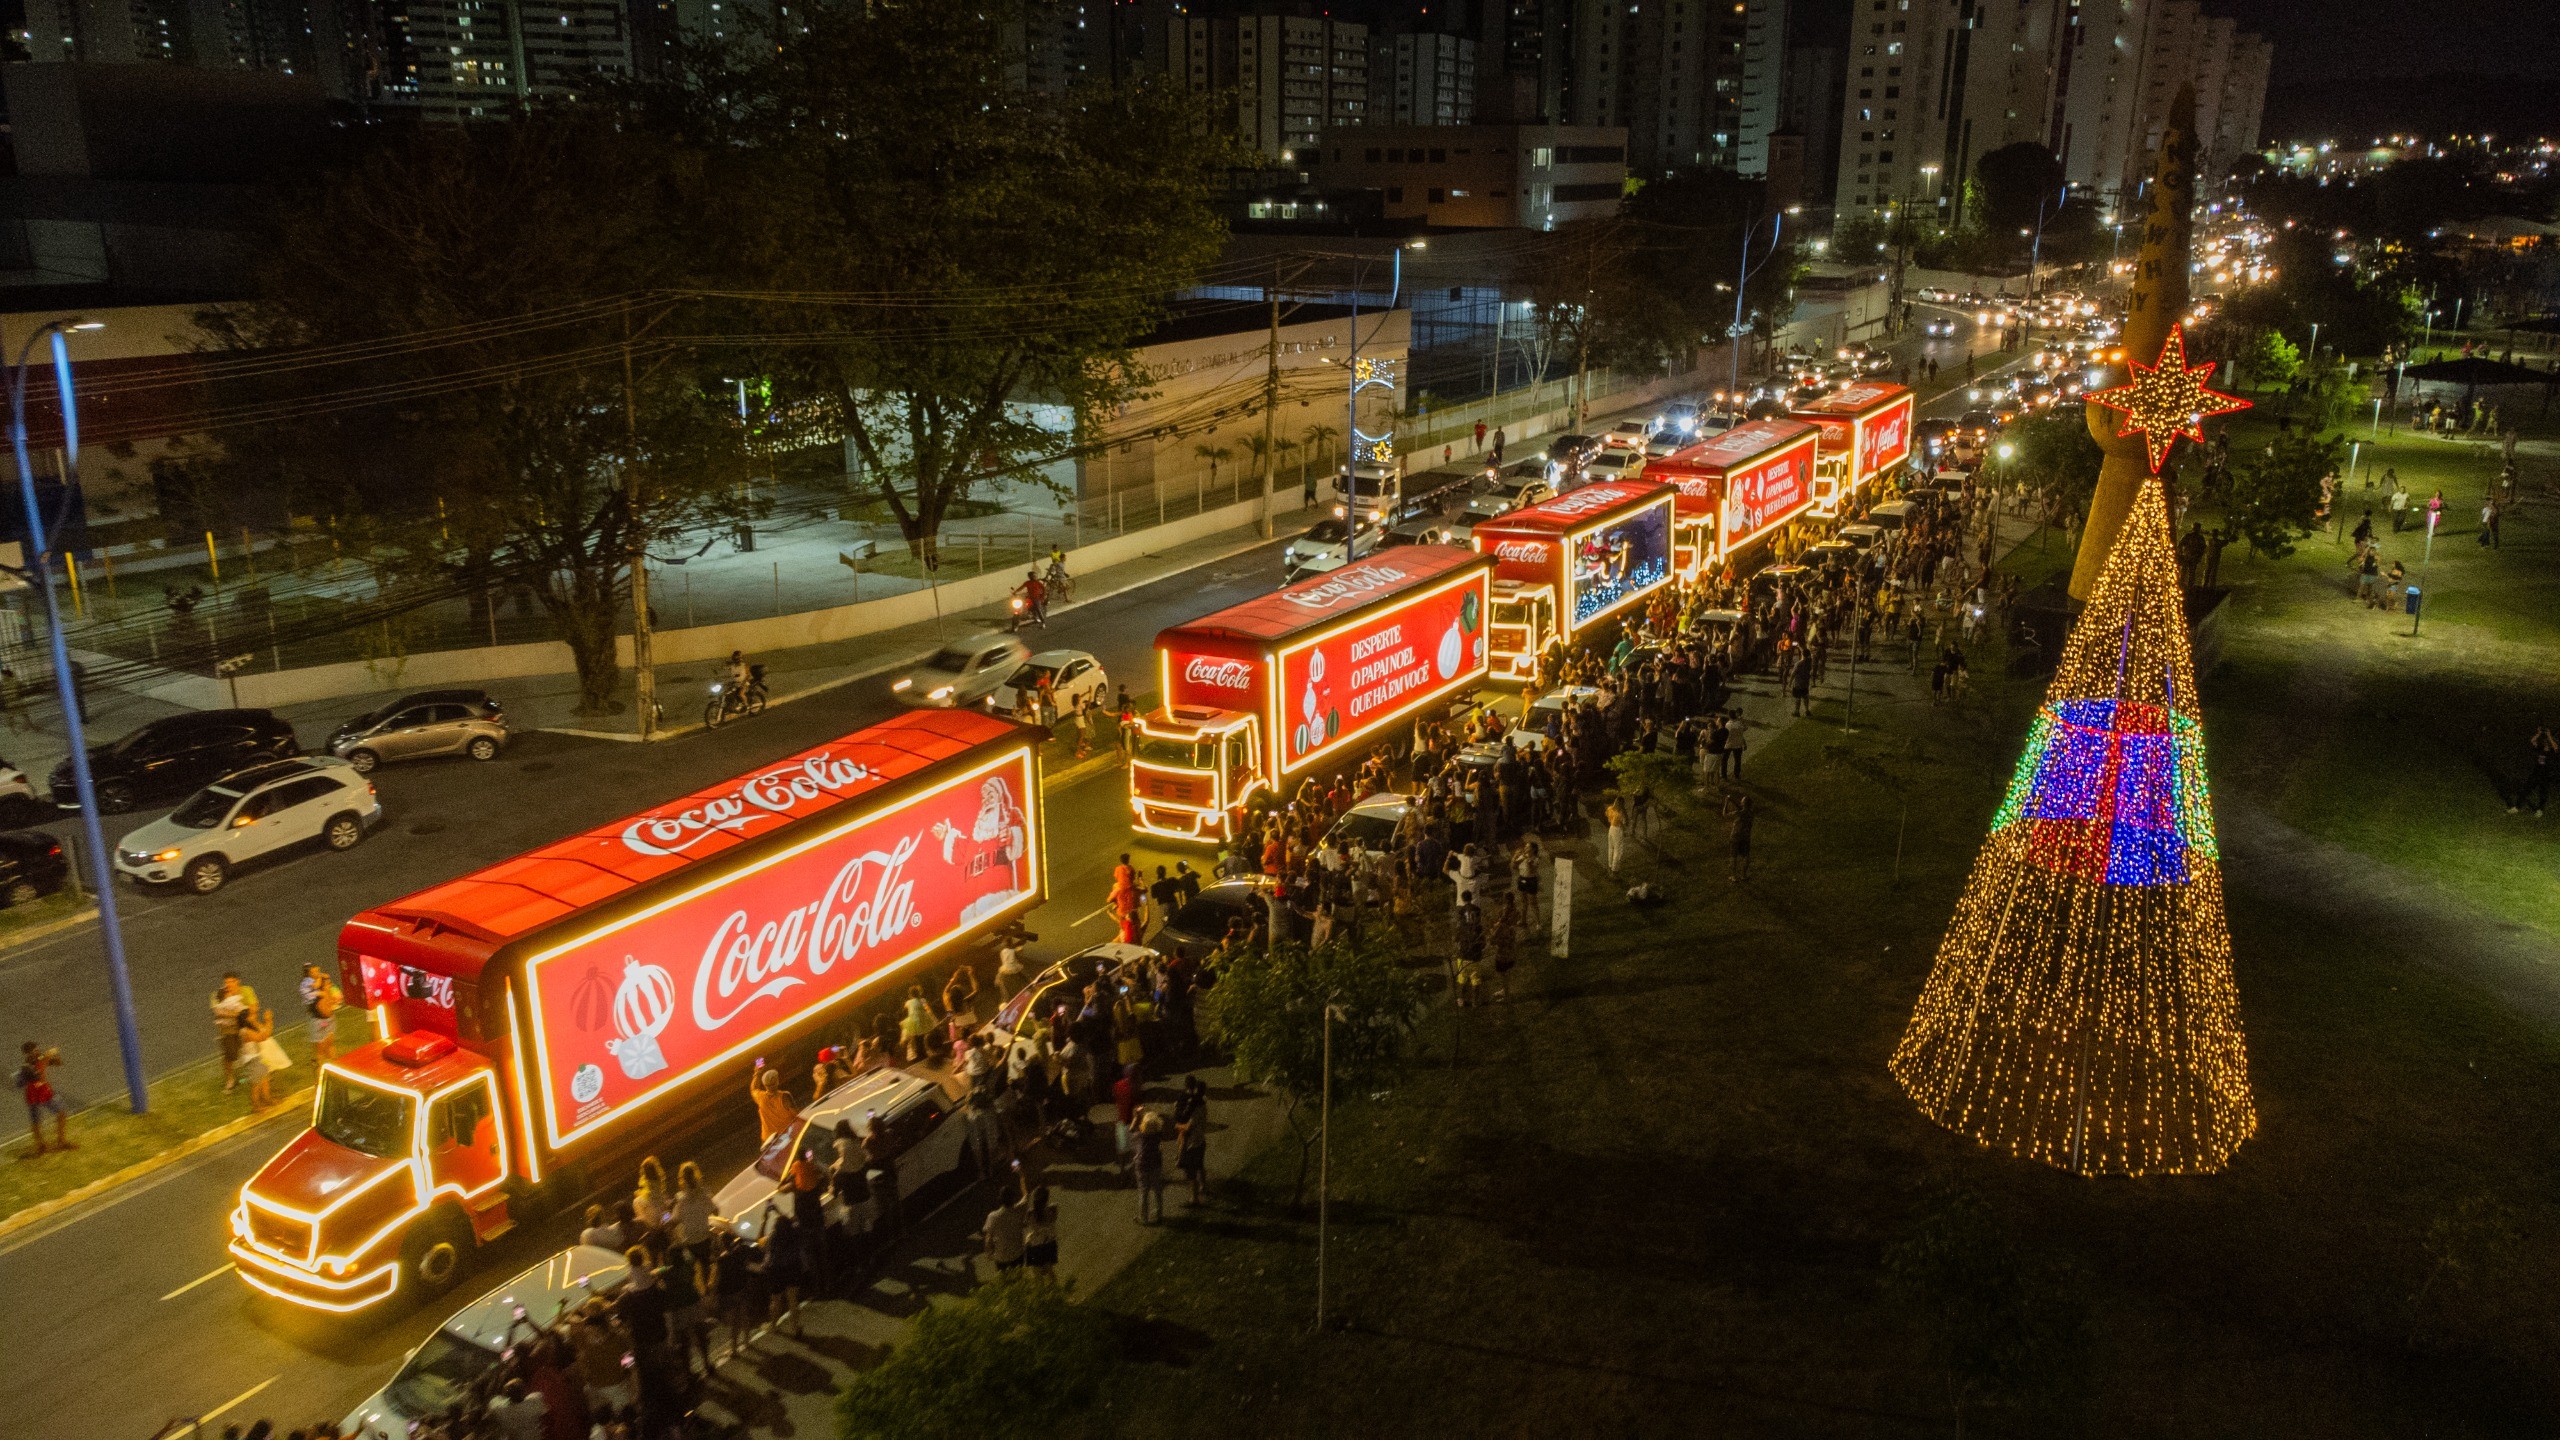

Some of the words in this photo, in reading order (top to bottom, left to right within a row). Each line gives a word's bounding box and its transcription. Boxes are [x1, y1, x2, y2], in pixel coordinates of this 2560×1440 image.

[1494, 541, 1549, 564] Coca-Cola
[1283, 565, 1406, 608] Coca-Cola
[1351, 624, 1402, 663] DESPERTE
[1185, 657, 1254, 690] Coca-Cola
[1350, 690, 1373, 717] QUE
[1373, 678, 1388, 707] HÁ
[1388, 676, 1404, 700] EM
[1404, 659, 1430, 691] VOCÊ
[1351, 670, 1361, 690] O
[1361, 656, 1389, 686] PAPAI
[1390, 646, 1416, 674] NOEL
[621, 751, 870, 856] Coca-Cola
[692, 829, 923, 1031] Coca-Cola
